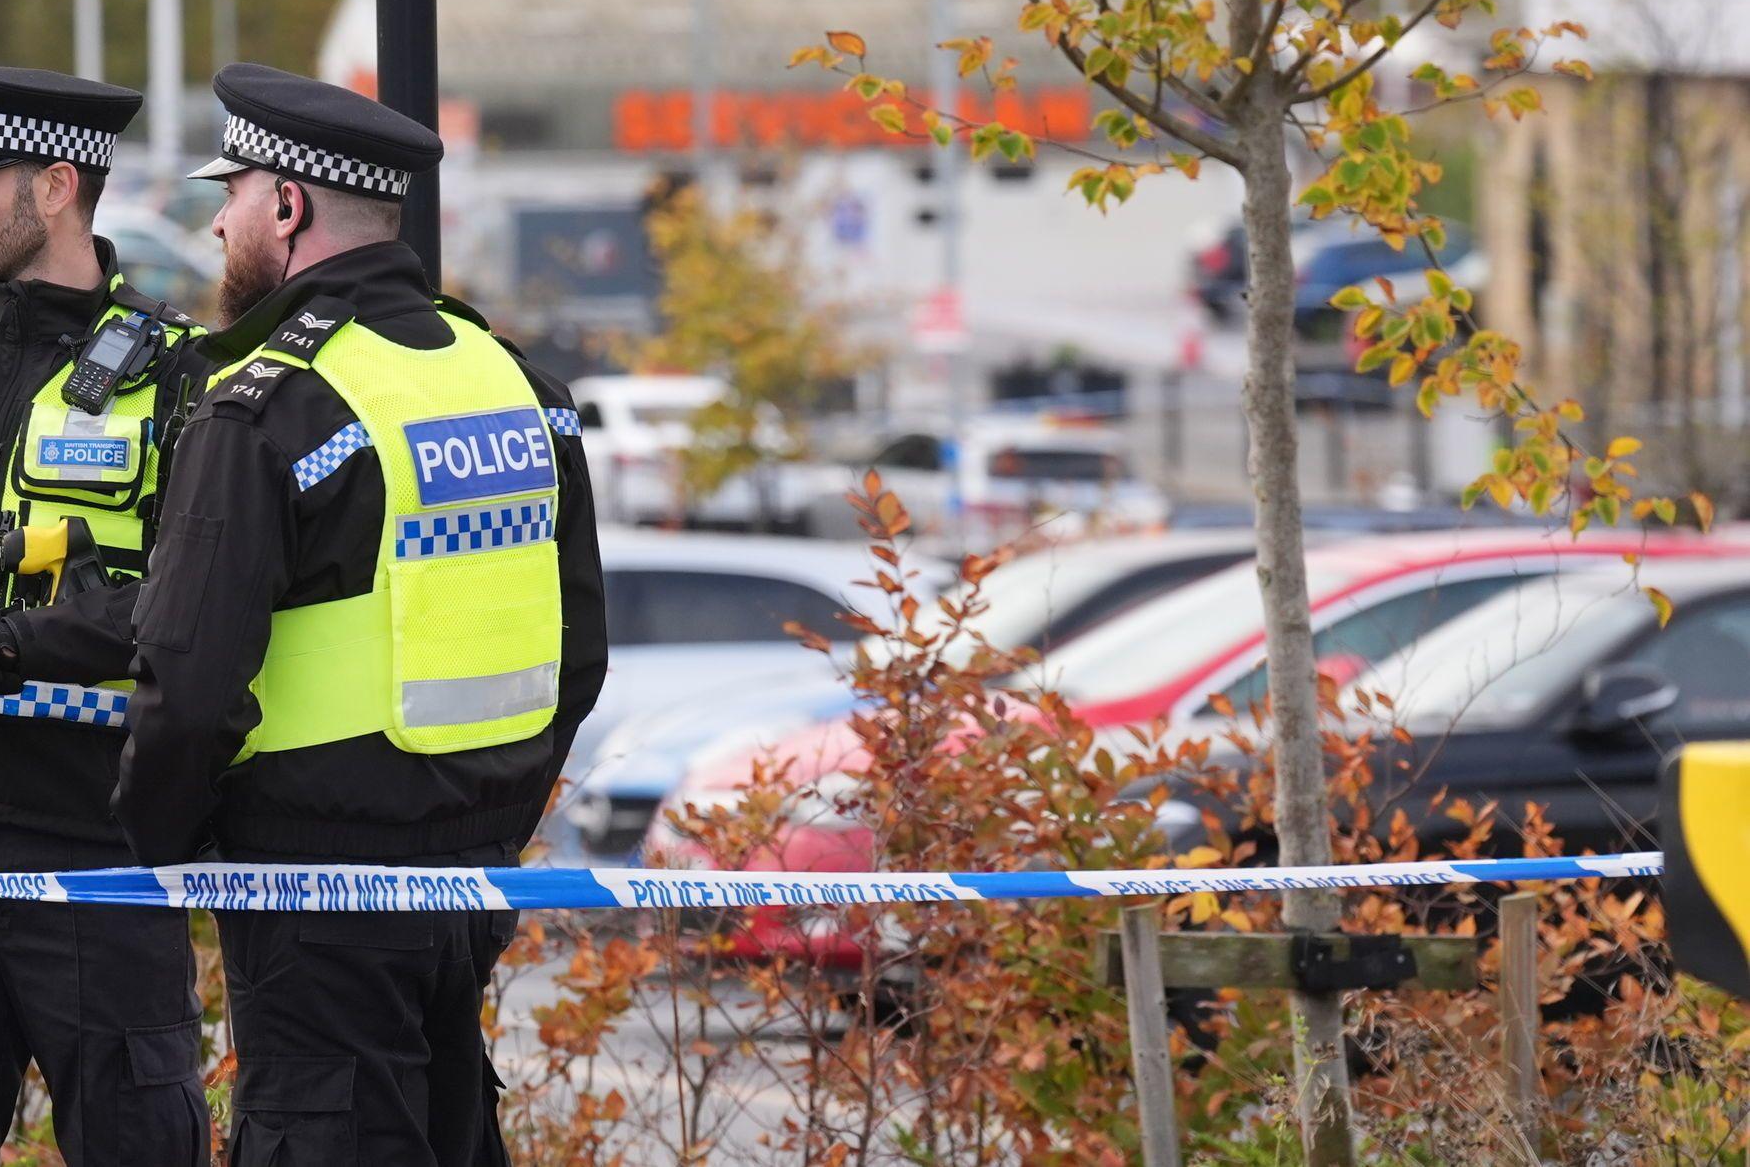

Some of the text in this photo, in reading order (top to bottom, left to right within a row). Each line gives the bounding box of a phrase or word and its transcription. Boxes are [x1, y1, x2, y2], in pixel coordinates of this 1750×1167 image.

[280, 331, 315, 349] 1741
[230, 384, 263, 400] 1741
[89, 442, 125, 450] TRANSPORT
[416, 427, 550, 483] POLICE
[63, 448, 124, 464] POLICE
[182, 872, 487, 911] POLICE LINE DO NOT CROSS
[627, 879, 714, 908] POLICE
[715, 881, 772, 907] LINE
